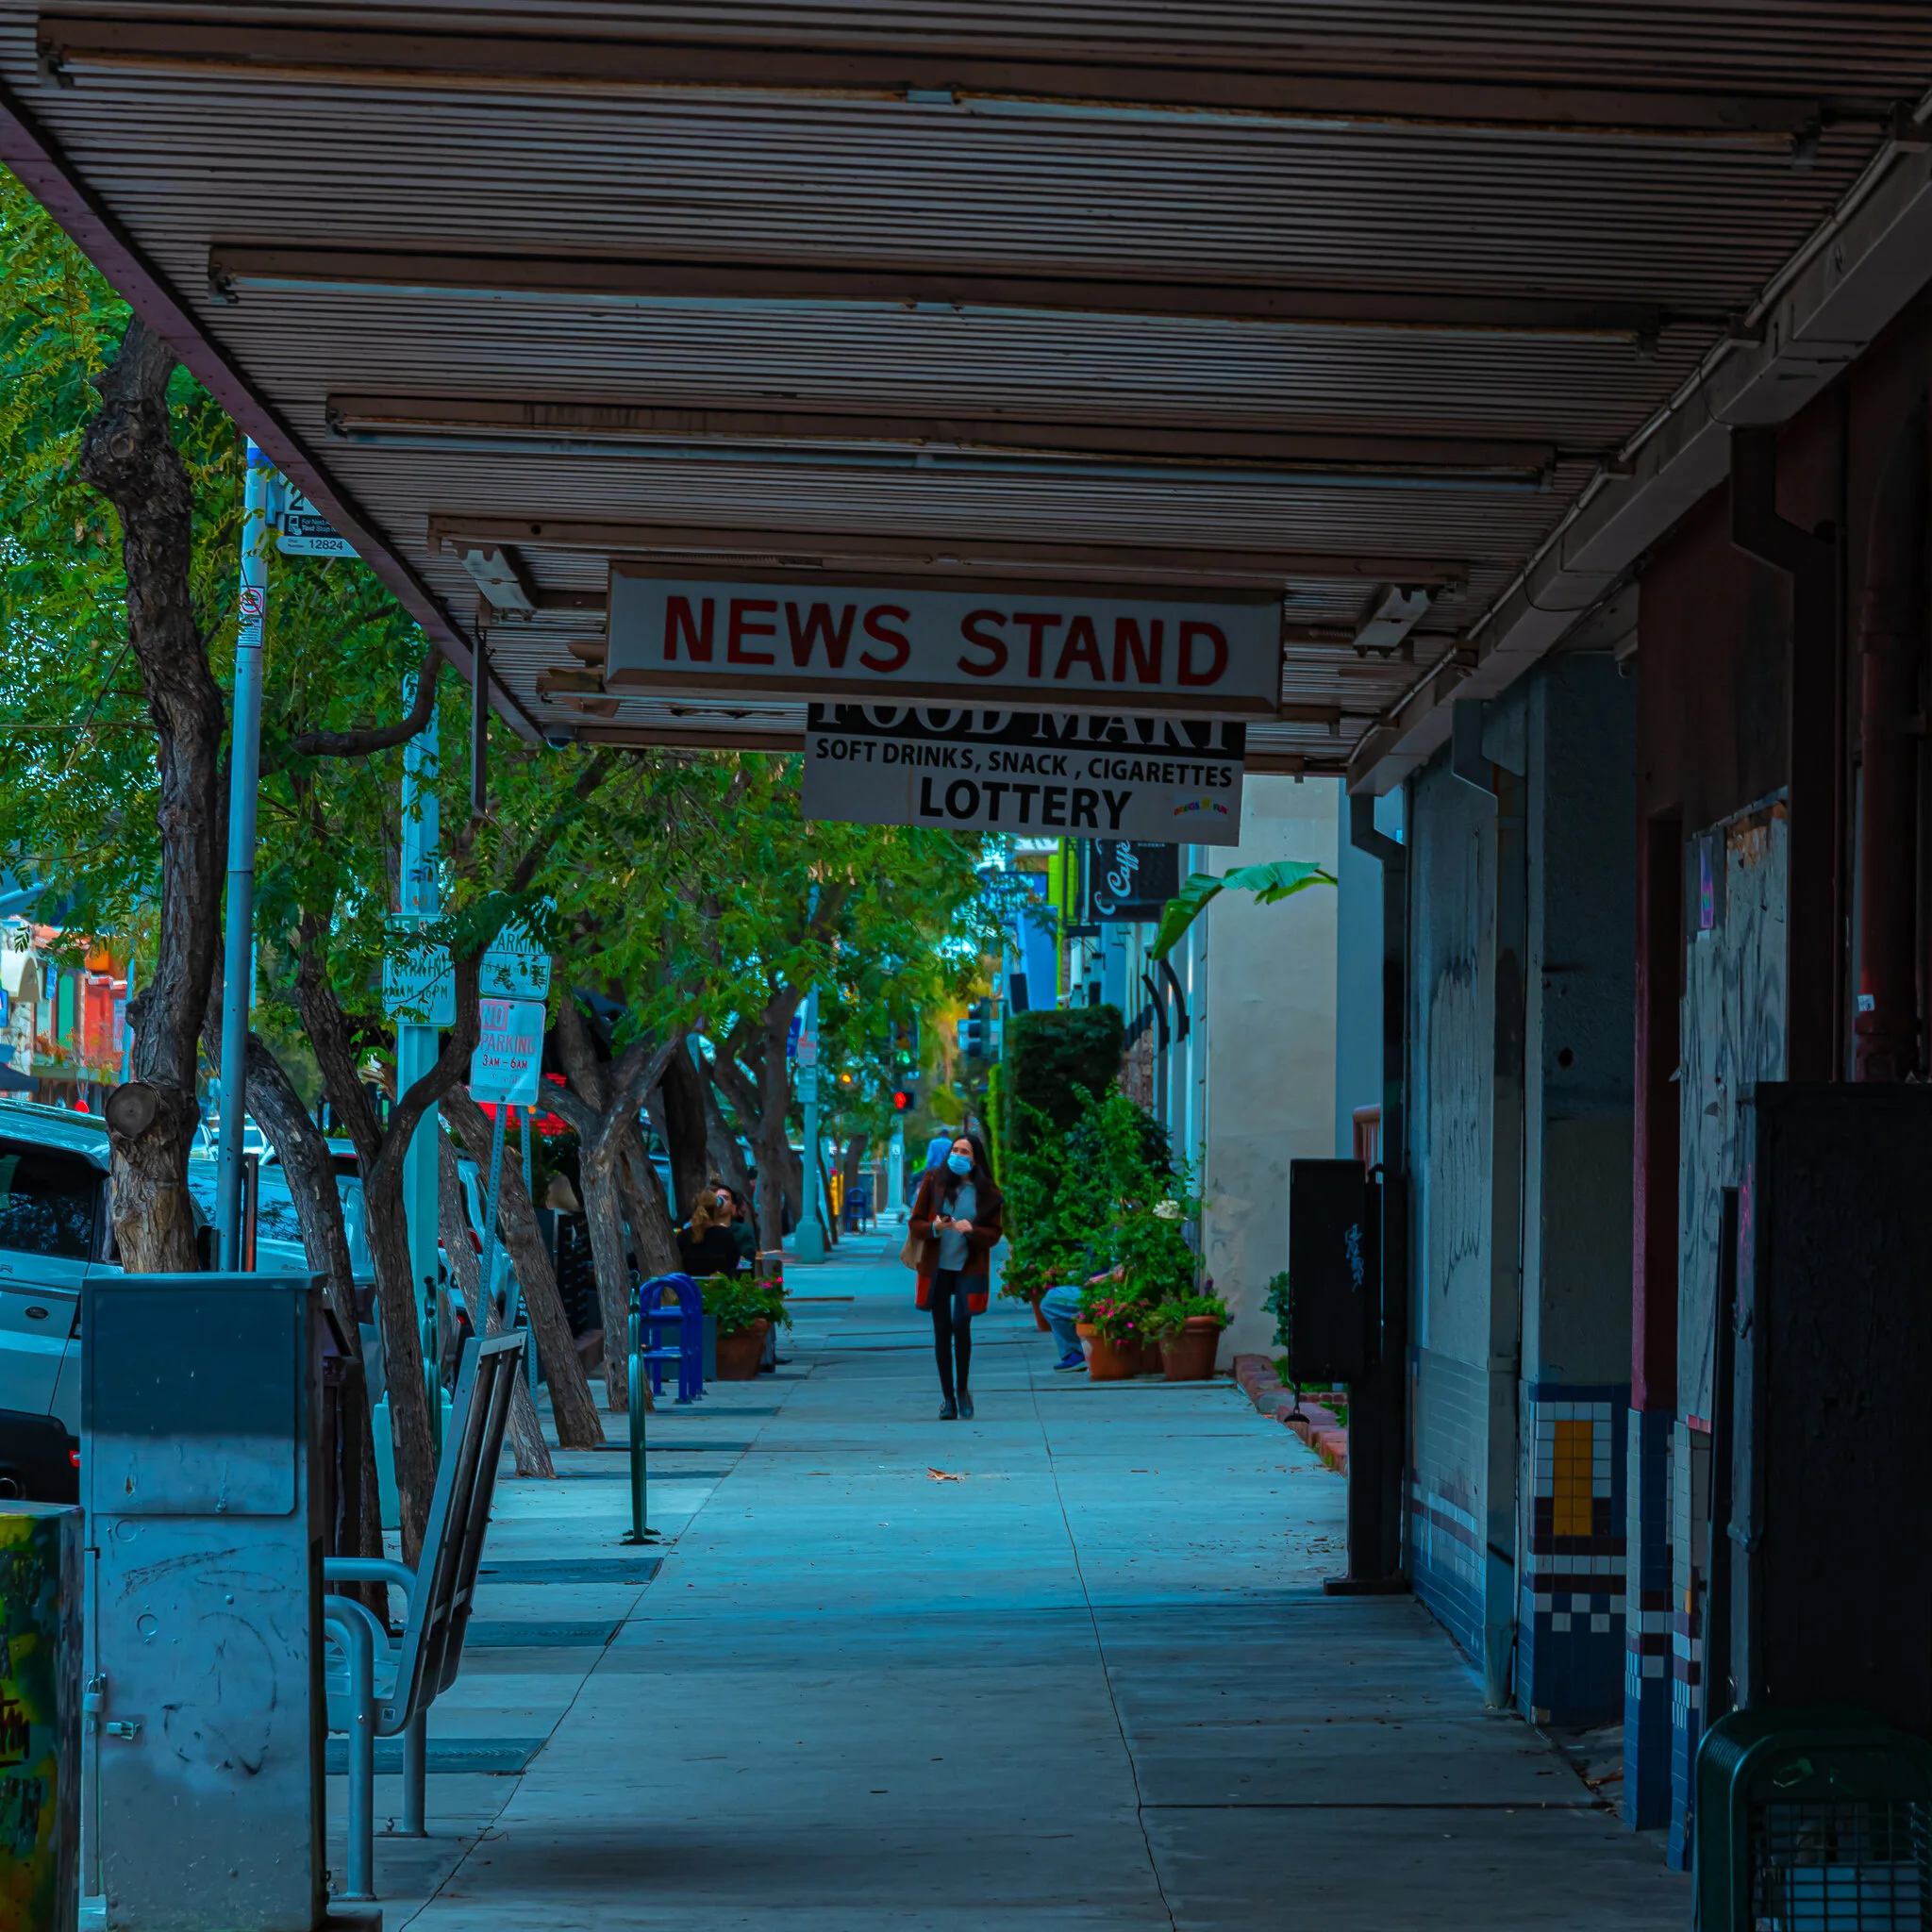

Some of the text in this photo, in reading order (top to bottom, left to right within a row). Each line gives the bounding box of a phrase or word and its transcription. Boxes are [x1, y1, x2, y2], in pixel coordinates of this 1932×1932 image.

[309, 539, 343, 550] 12824
[663, 595, 1228, 687] NEWS STAND
[816, 738, 876, 762] SOFT
[883, 742, 981, 773] DRINKS,
[988, 751, 1068, 776] SNACK
[1088, 758, 1232, 788] CIGARETTES
[920, 776, 1133, 830] LOTTERY
[482, 1004, 505, 1027] NO
[479, 1033, 536, 1056] PARKING
[482, 1054, 500, 1067] 3AM
[510, 1057, 527, 1069] 6AM
